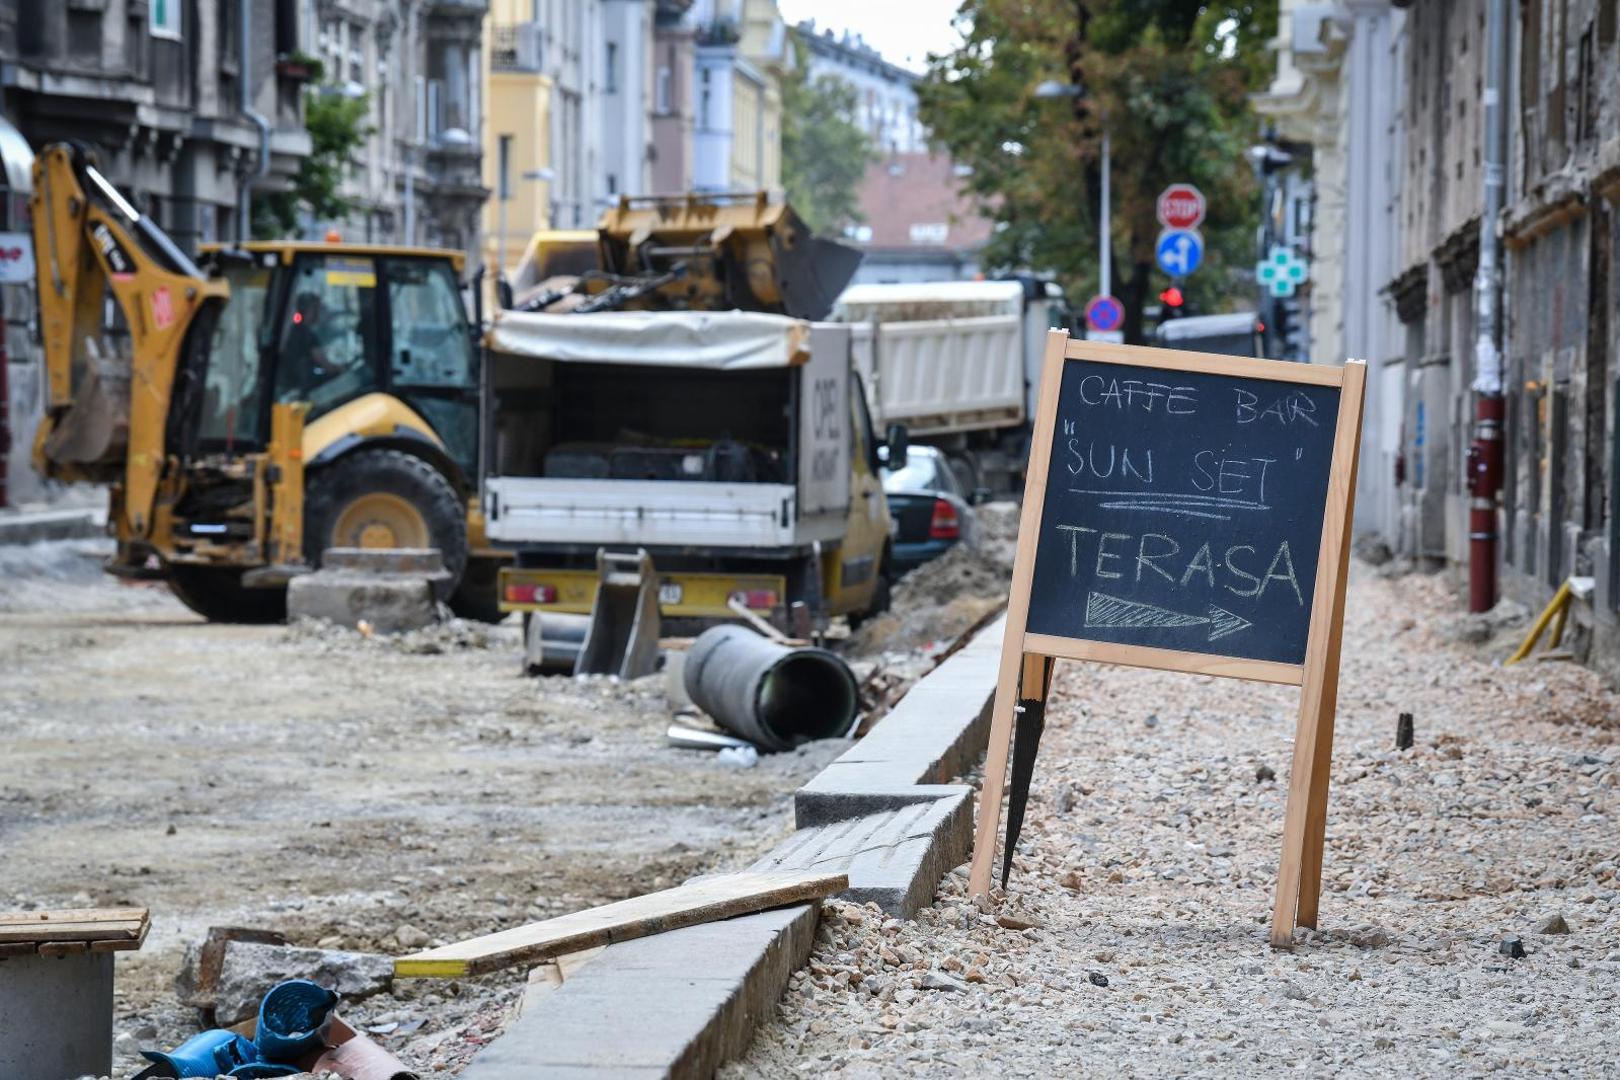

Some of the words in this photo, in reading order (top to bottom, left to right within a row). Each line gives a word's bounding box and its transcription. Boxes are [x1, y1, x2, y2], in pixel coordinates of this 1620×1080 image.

[1163, 199, 1199, 217] STOP
[1080, 375, 1199, 414] CAFFE
[1234, 388, 1319, 426] BAR
[1056, 524, 1303, 606] TERASA
